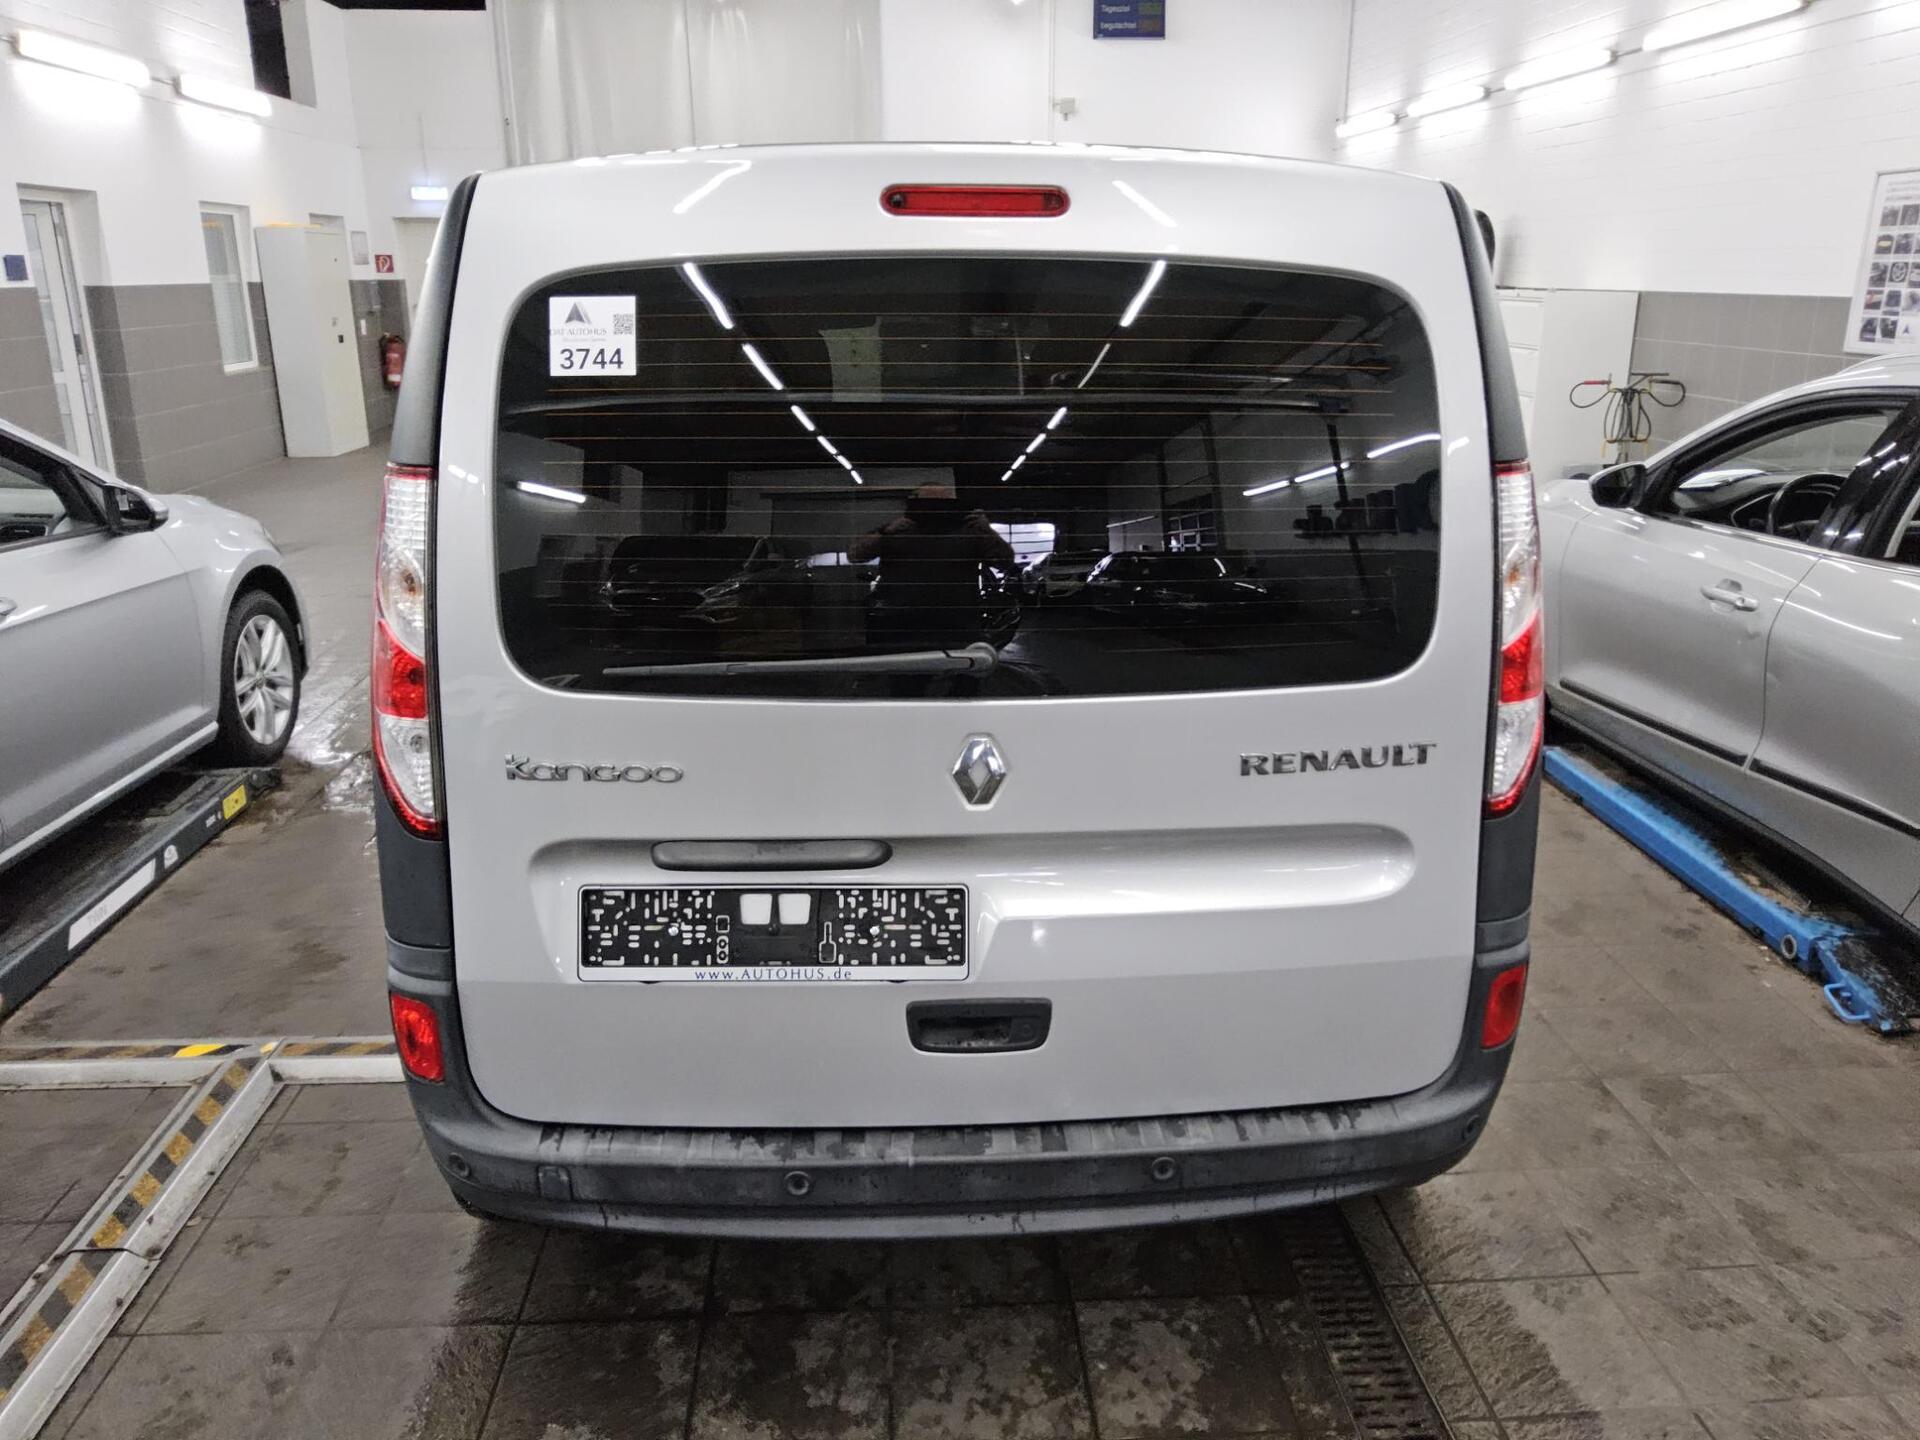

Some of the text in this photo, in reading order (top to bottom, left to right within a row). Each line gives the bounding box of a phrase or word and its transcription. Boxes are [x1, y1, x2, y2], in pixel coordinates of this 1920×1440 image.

[567, 328, 607, 336] AUTOHUS
[560, 348, 623, 370] 3744
[1239, 742, 1437, 776] RENAULT
[695, 967, 852, 981] www.AUTOHUS.de
